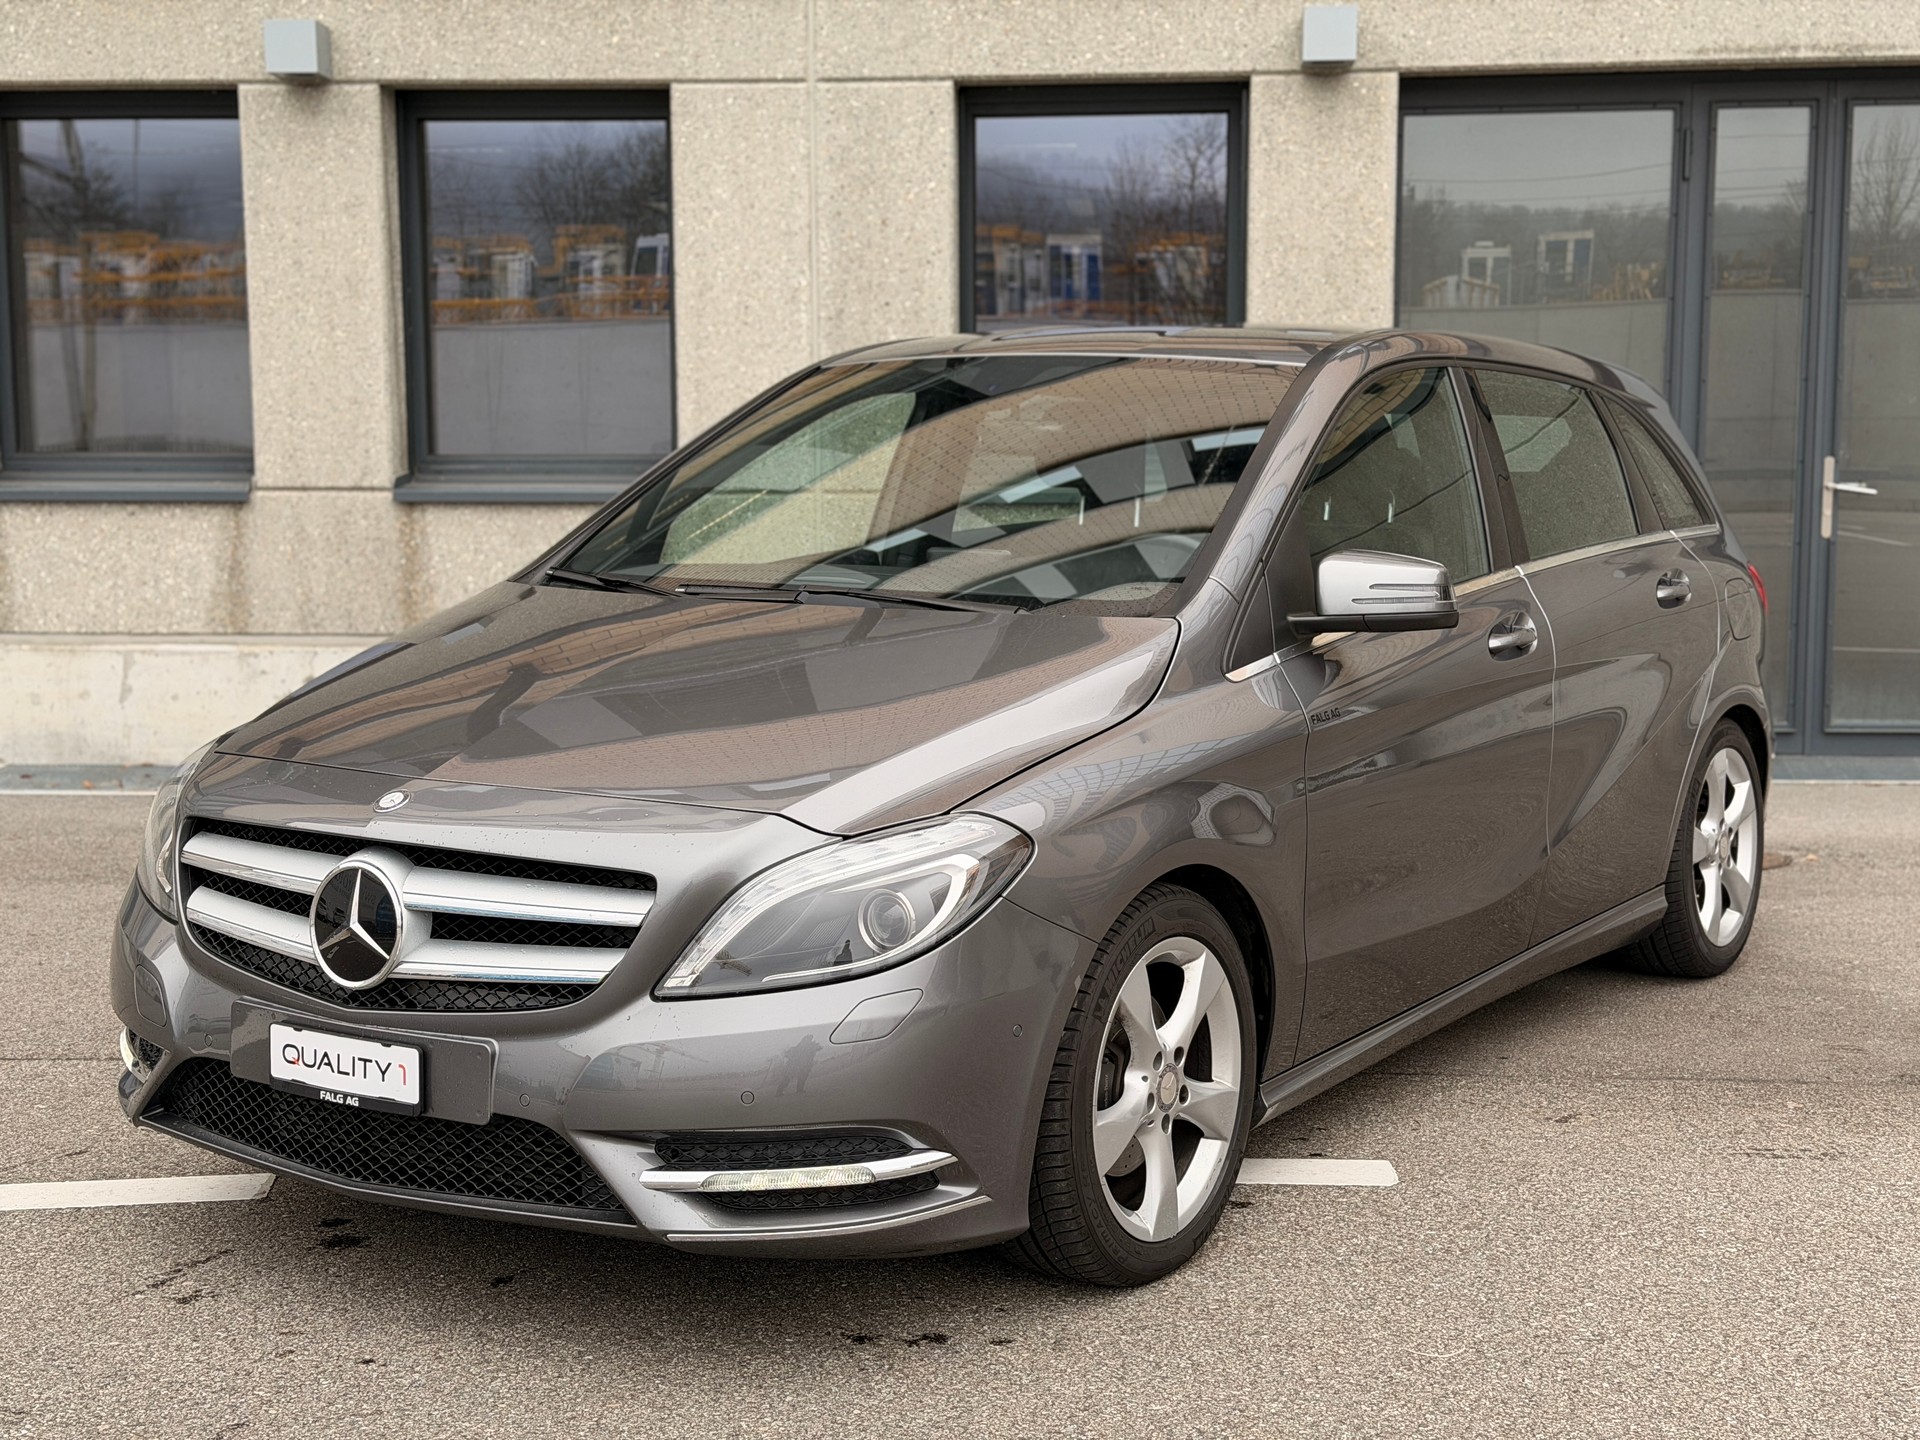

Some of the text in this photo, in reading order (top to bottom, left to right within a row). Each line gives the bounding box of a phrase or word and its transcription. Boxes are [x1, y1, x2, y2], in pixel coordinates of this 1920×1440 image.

[1310, 707, 1341, 725] FALG AG
[282, 1043, 392, 1082] QUALITY
[320, 1090, 359, 1107] FALG AG
